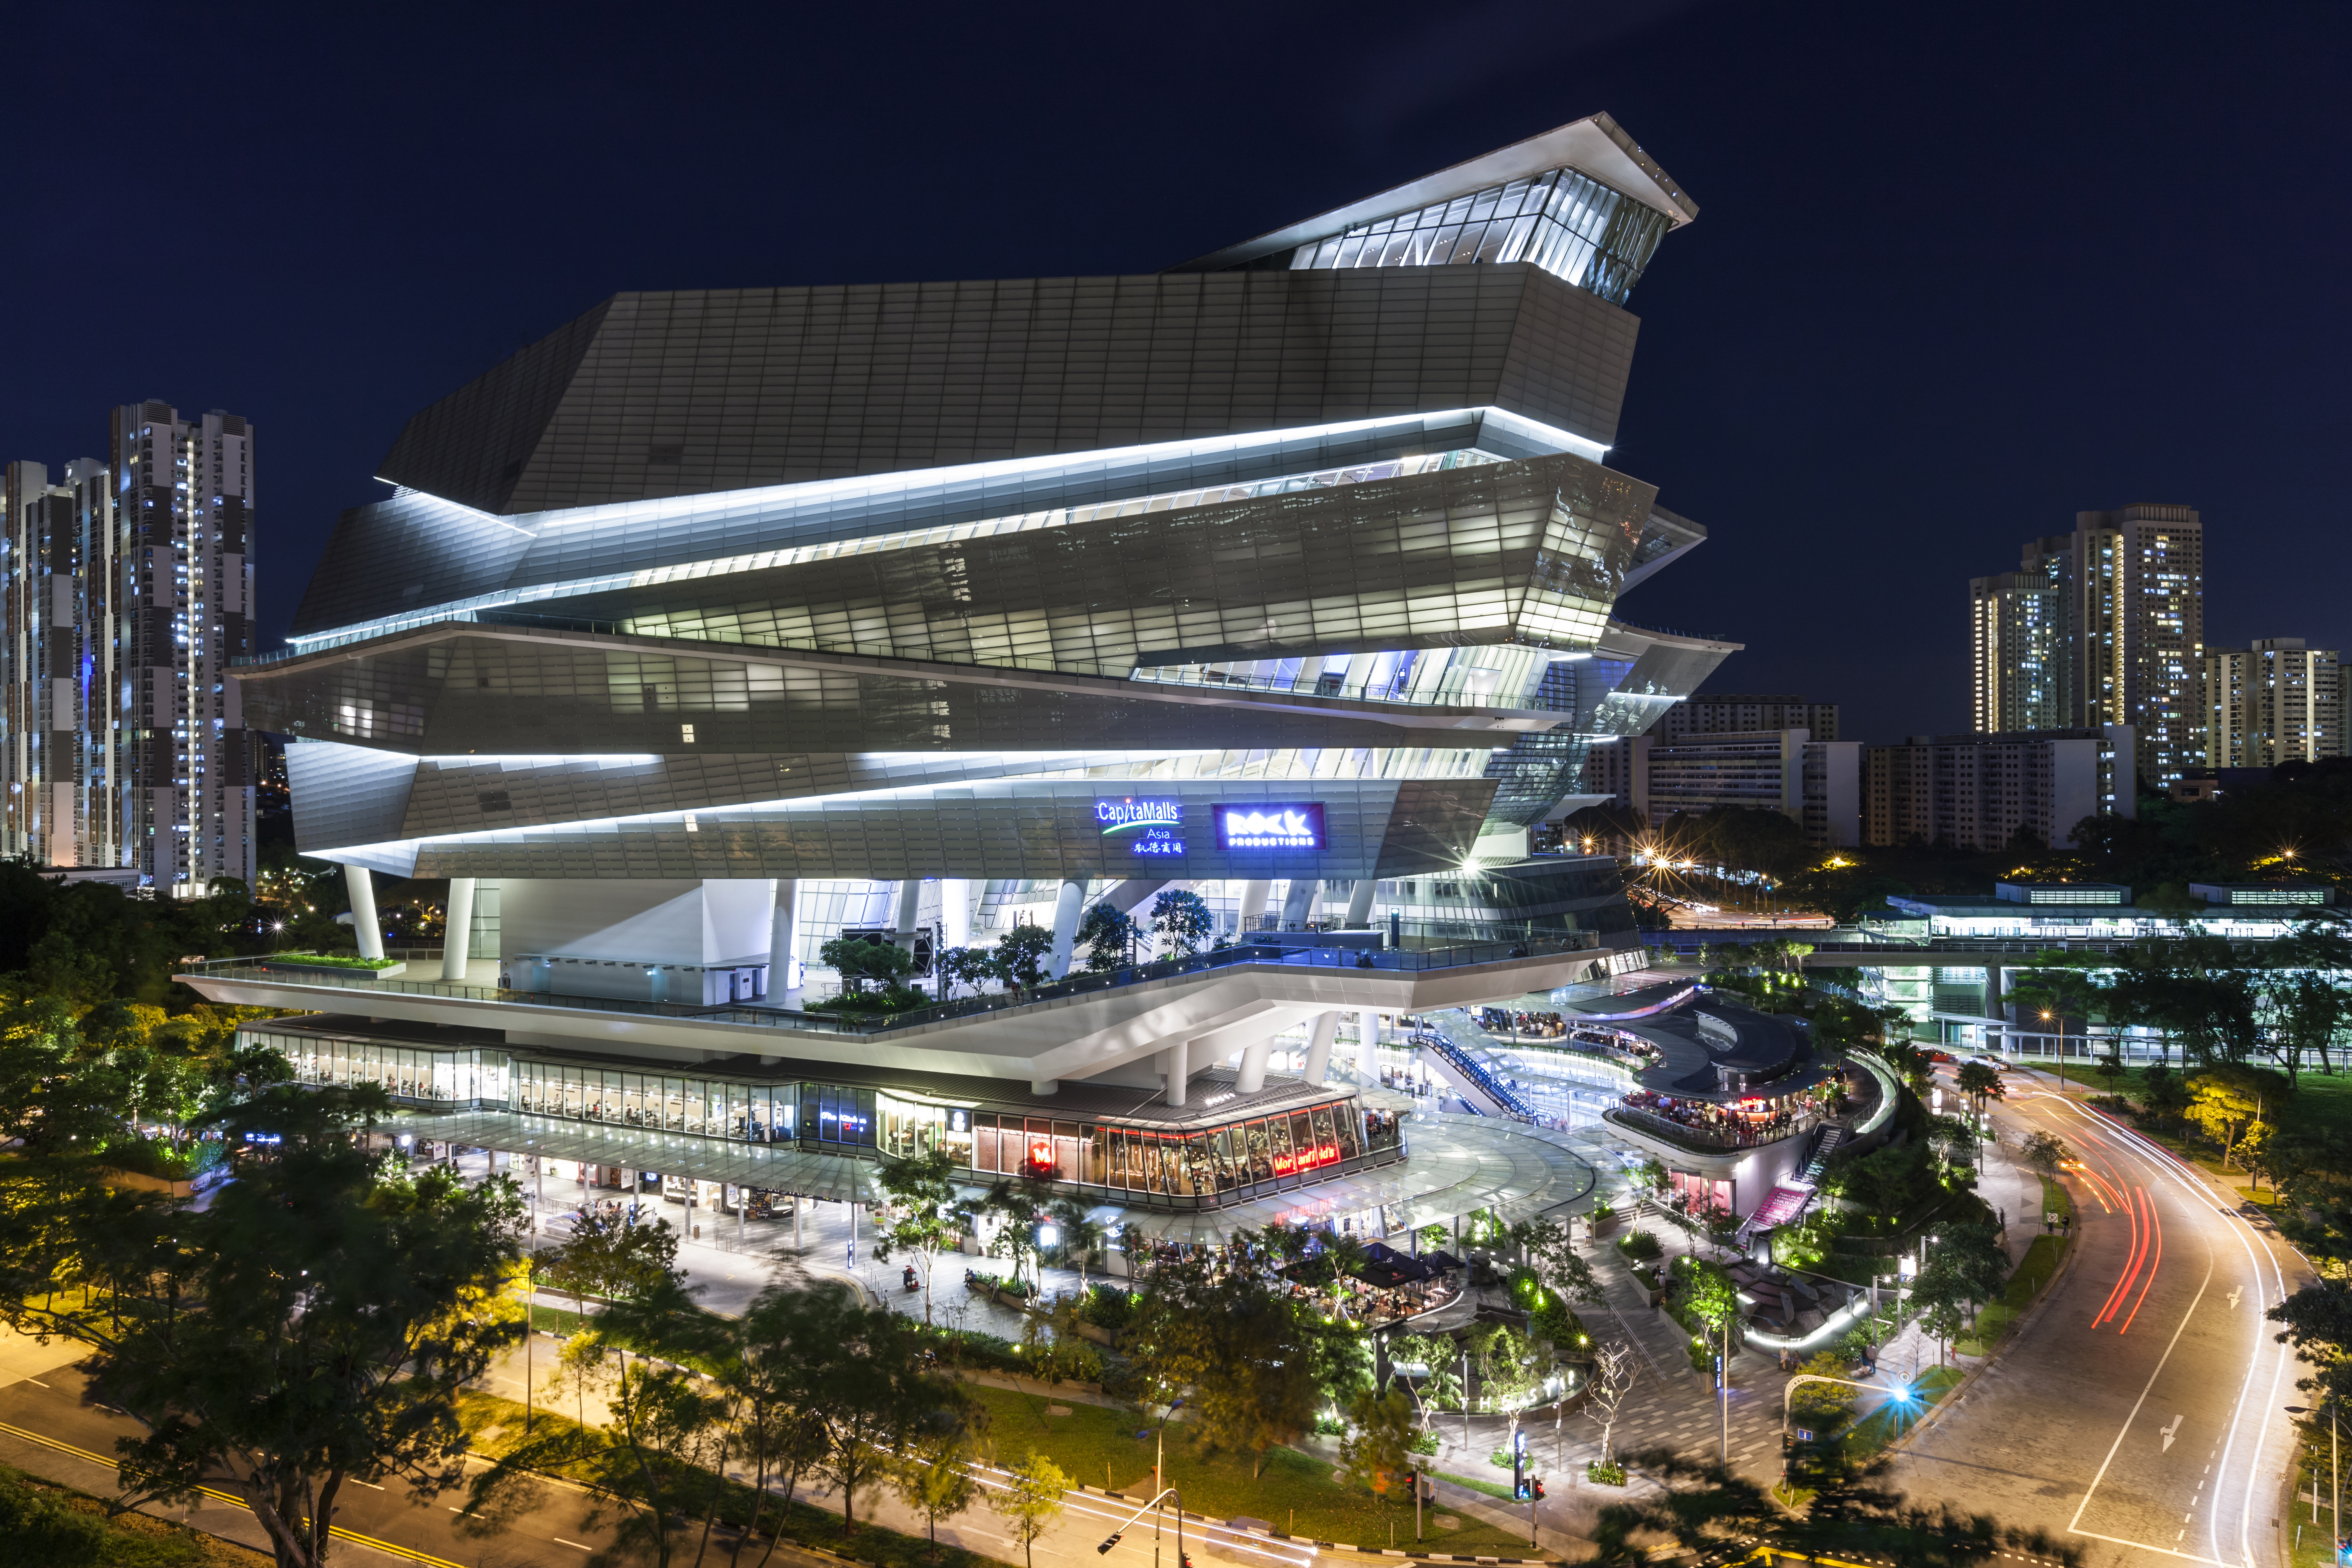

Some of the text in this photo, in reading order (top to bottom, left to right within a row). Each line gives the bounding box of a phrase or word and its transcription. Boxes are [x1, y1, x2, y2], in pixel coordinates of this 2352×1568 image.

[1098, 799, 1178, 825] CapitaMalls
[1227, 810, 1312, 836] ROCK
[1147, 828, 1170, 839] Asia
[1229, 837, 1314, 846] PRODUCTIONS
